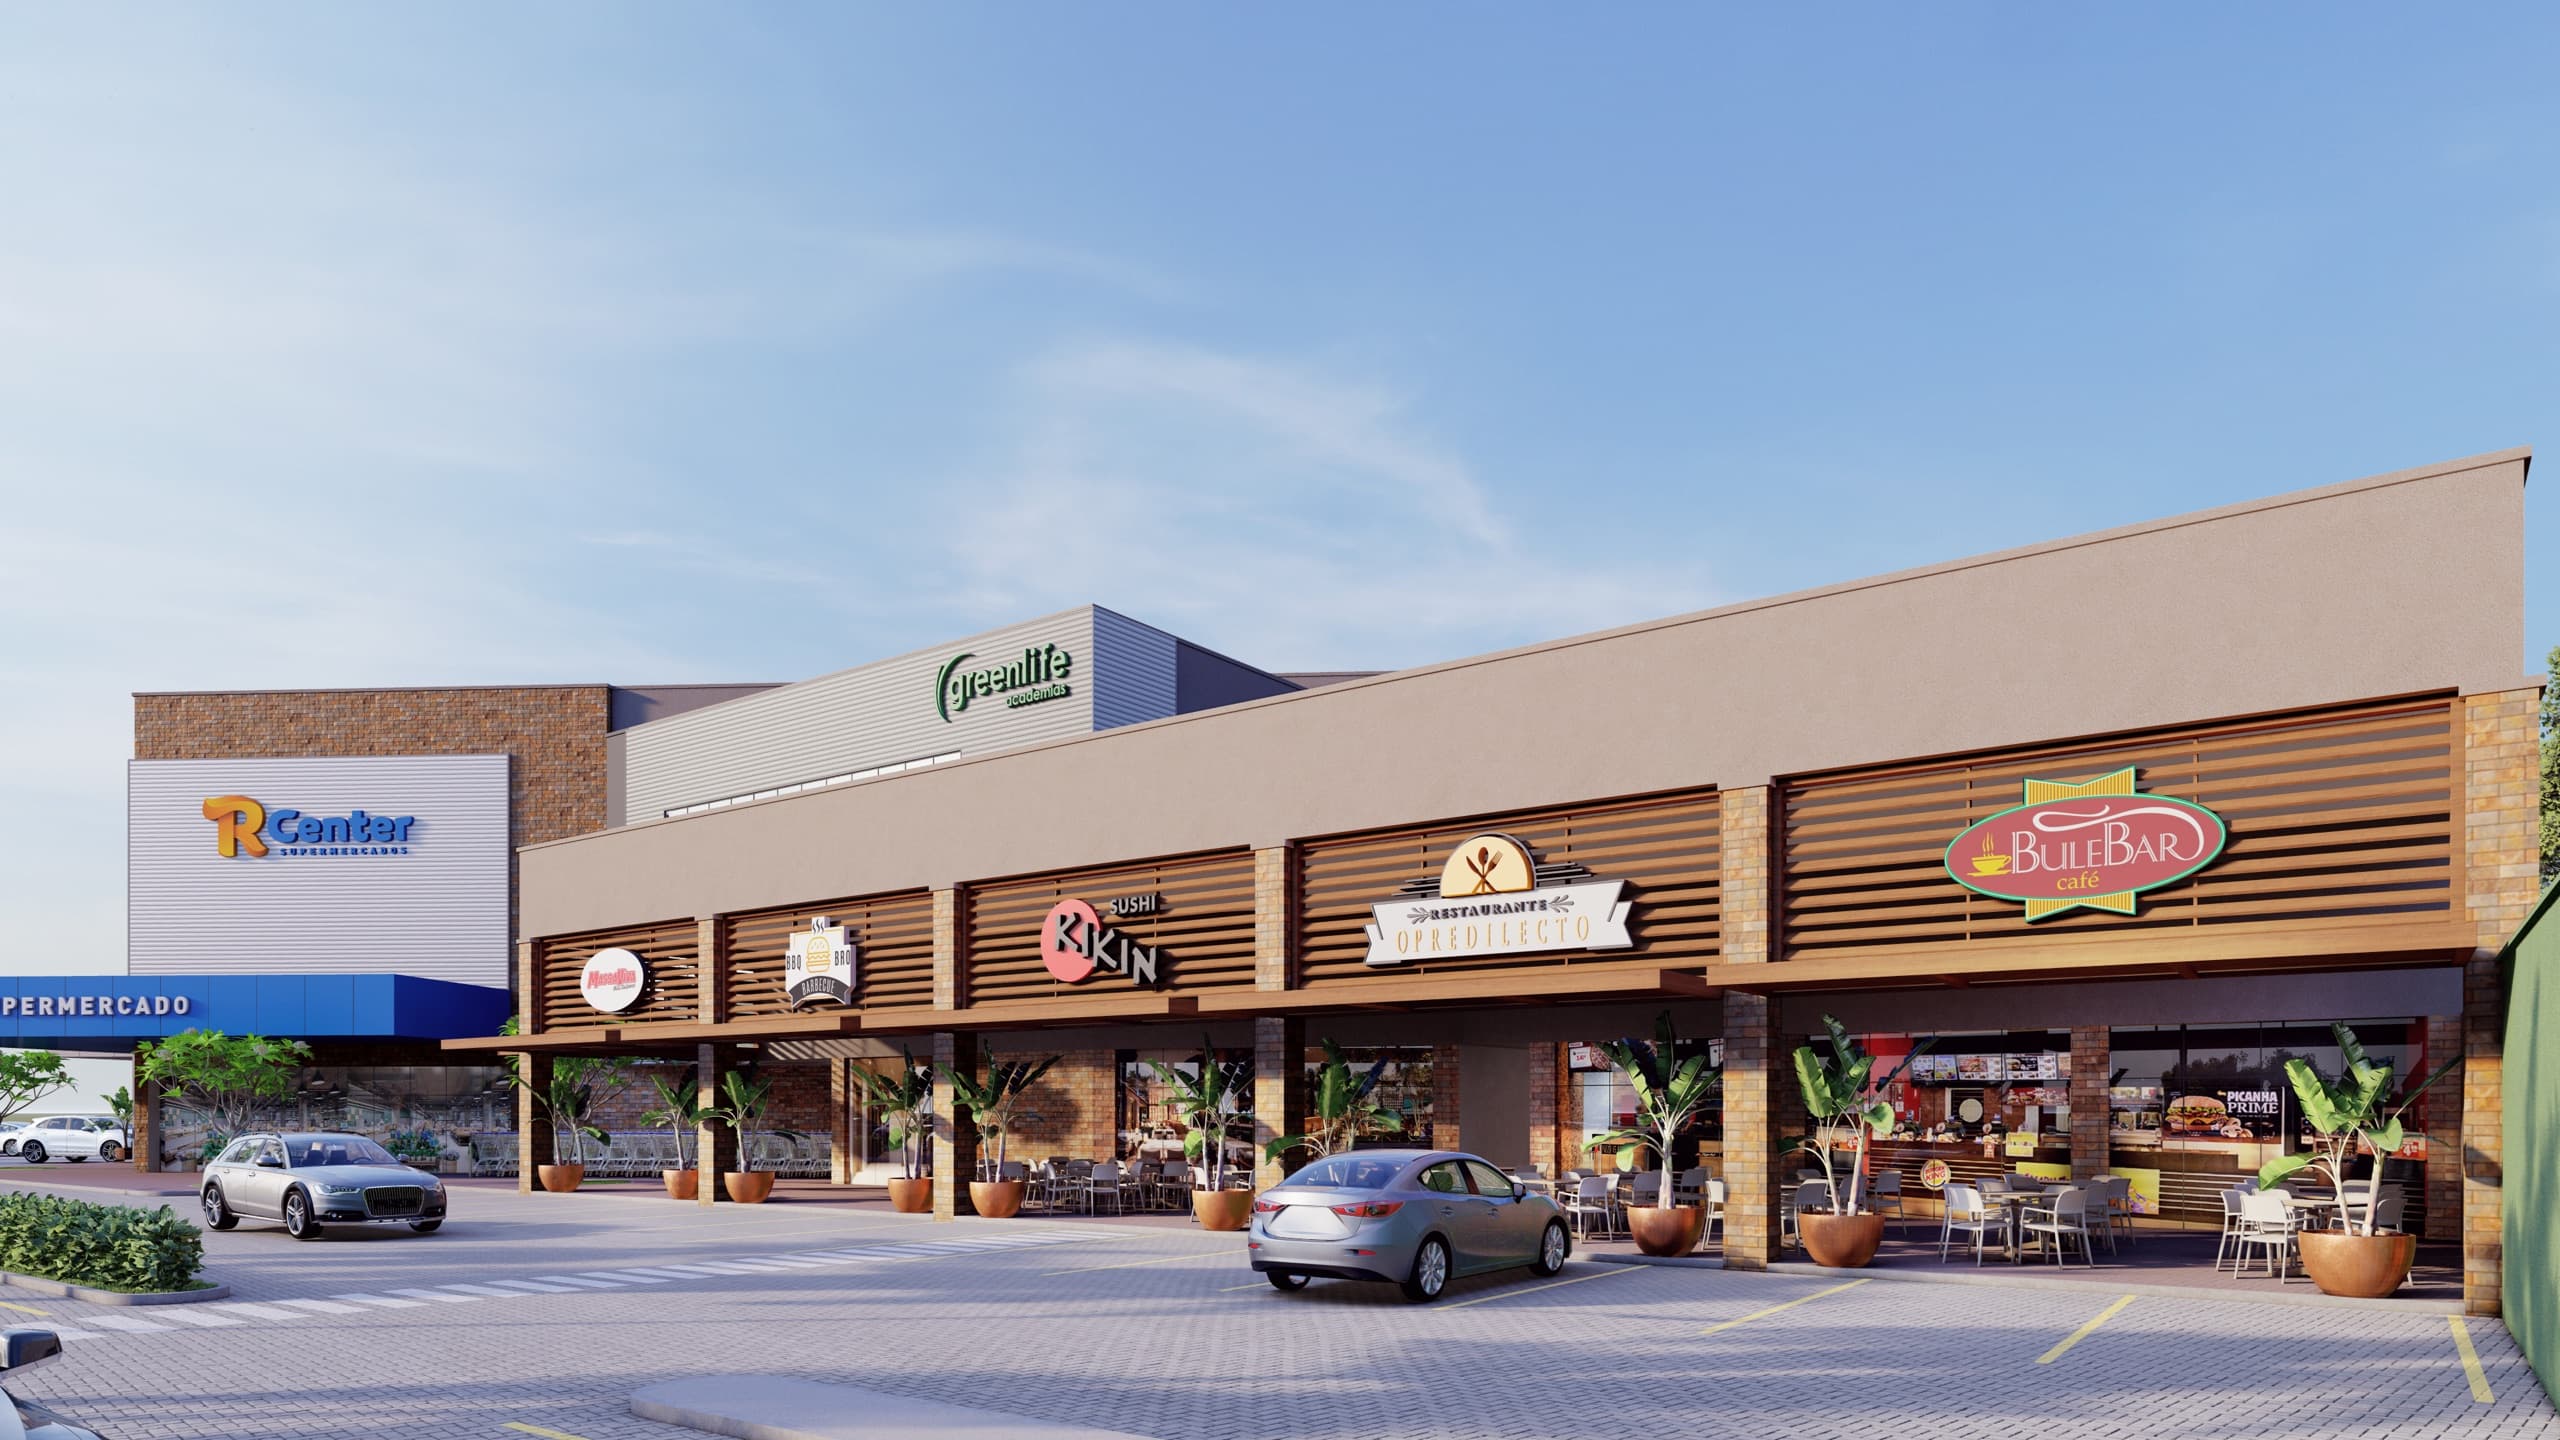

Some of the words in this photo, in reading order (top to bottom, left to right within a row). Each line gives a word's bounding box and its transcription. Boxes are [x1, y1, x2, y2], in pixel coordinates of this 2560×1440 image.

[949, 642, 1071, 711] greenlife
[1006, 683, 1069, 708] academias
[267, 809, 415, 843] Center
[279, 847, 408, 856] SUPERMERCADOS
[2056, 870, 2100, 891] café
[1109, 896, 1156, 915] SUSHI
[1429, 899, 1548, 920] RESTAURANTE
[1055, 912, 1158, 985] KIKIN
[786, 954, 802, 971] BBQ
[801, 978, 835, 996] BARBECUE
[2, 996, 190, 1016] PERMERCADO
[2227, 1091, 2278, 1102] PICANHA
[2227, 1102, 2279, 1114] PRIME
